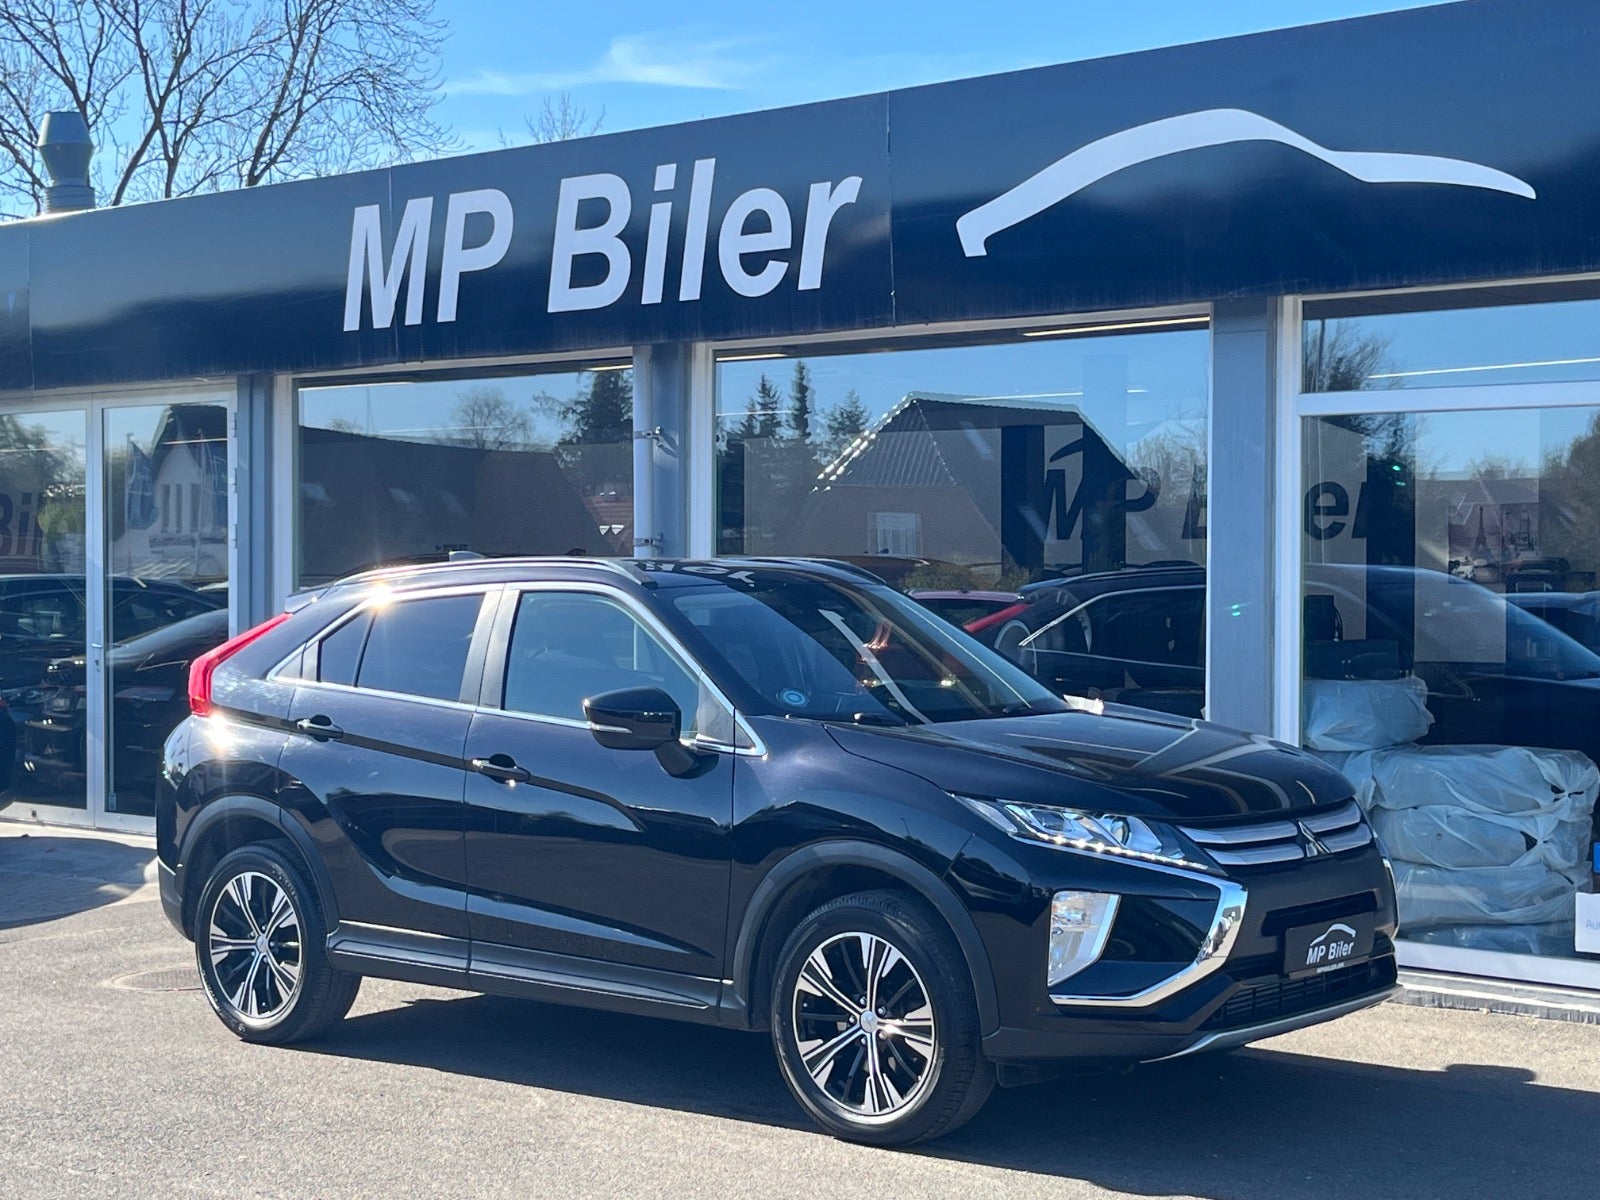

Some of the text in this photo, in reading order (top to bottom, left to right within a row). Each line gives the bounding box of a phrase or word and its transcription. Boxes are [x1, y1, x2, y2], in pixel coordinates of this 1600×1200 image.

[343, 157, 862, 332] MP Biler
[1306, 940, 1354, 965] MP Biler
